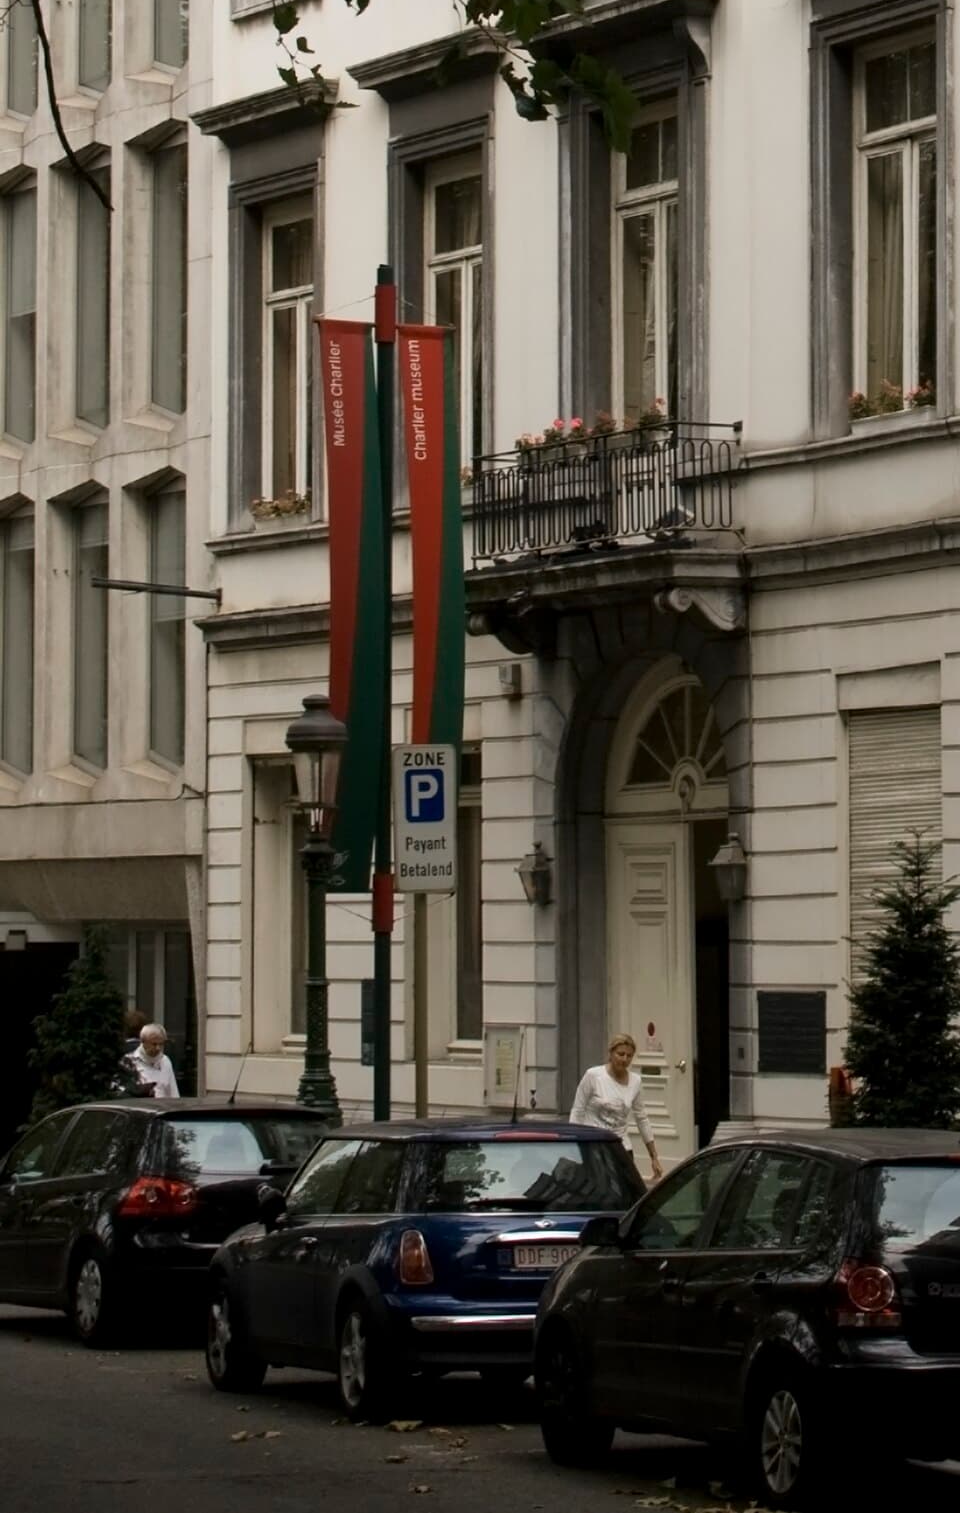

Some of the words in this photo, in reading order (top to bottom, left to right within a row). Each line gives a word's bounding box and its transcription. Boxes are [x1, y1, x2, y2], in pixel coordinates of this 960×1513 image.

[328, 340, 343, 397] Charlier
[408, 339, 424, 401] museum
[332, 400, 345, 447] Musée
[412, 404, 427, 461] Charlier
[403, 752, 445, 766] ZONE
[410, 774, 439, 817] P
[405, 836, 447, 854] Payant
[400, 861, 453, 877] Betalend
